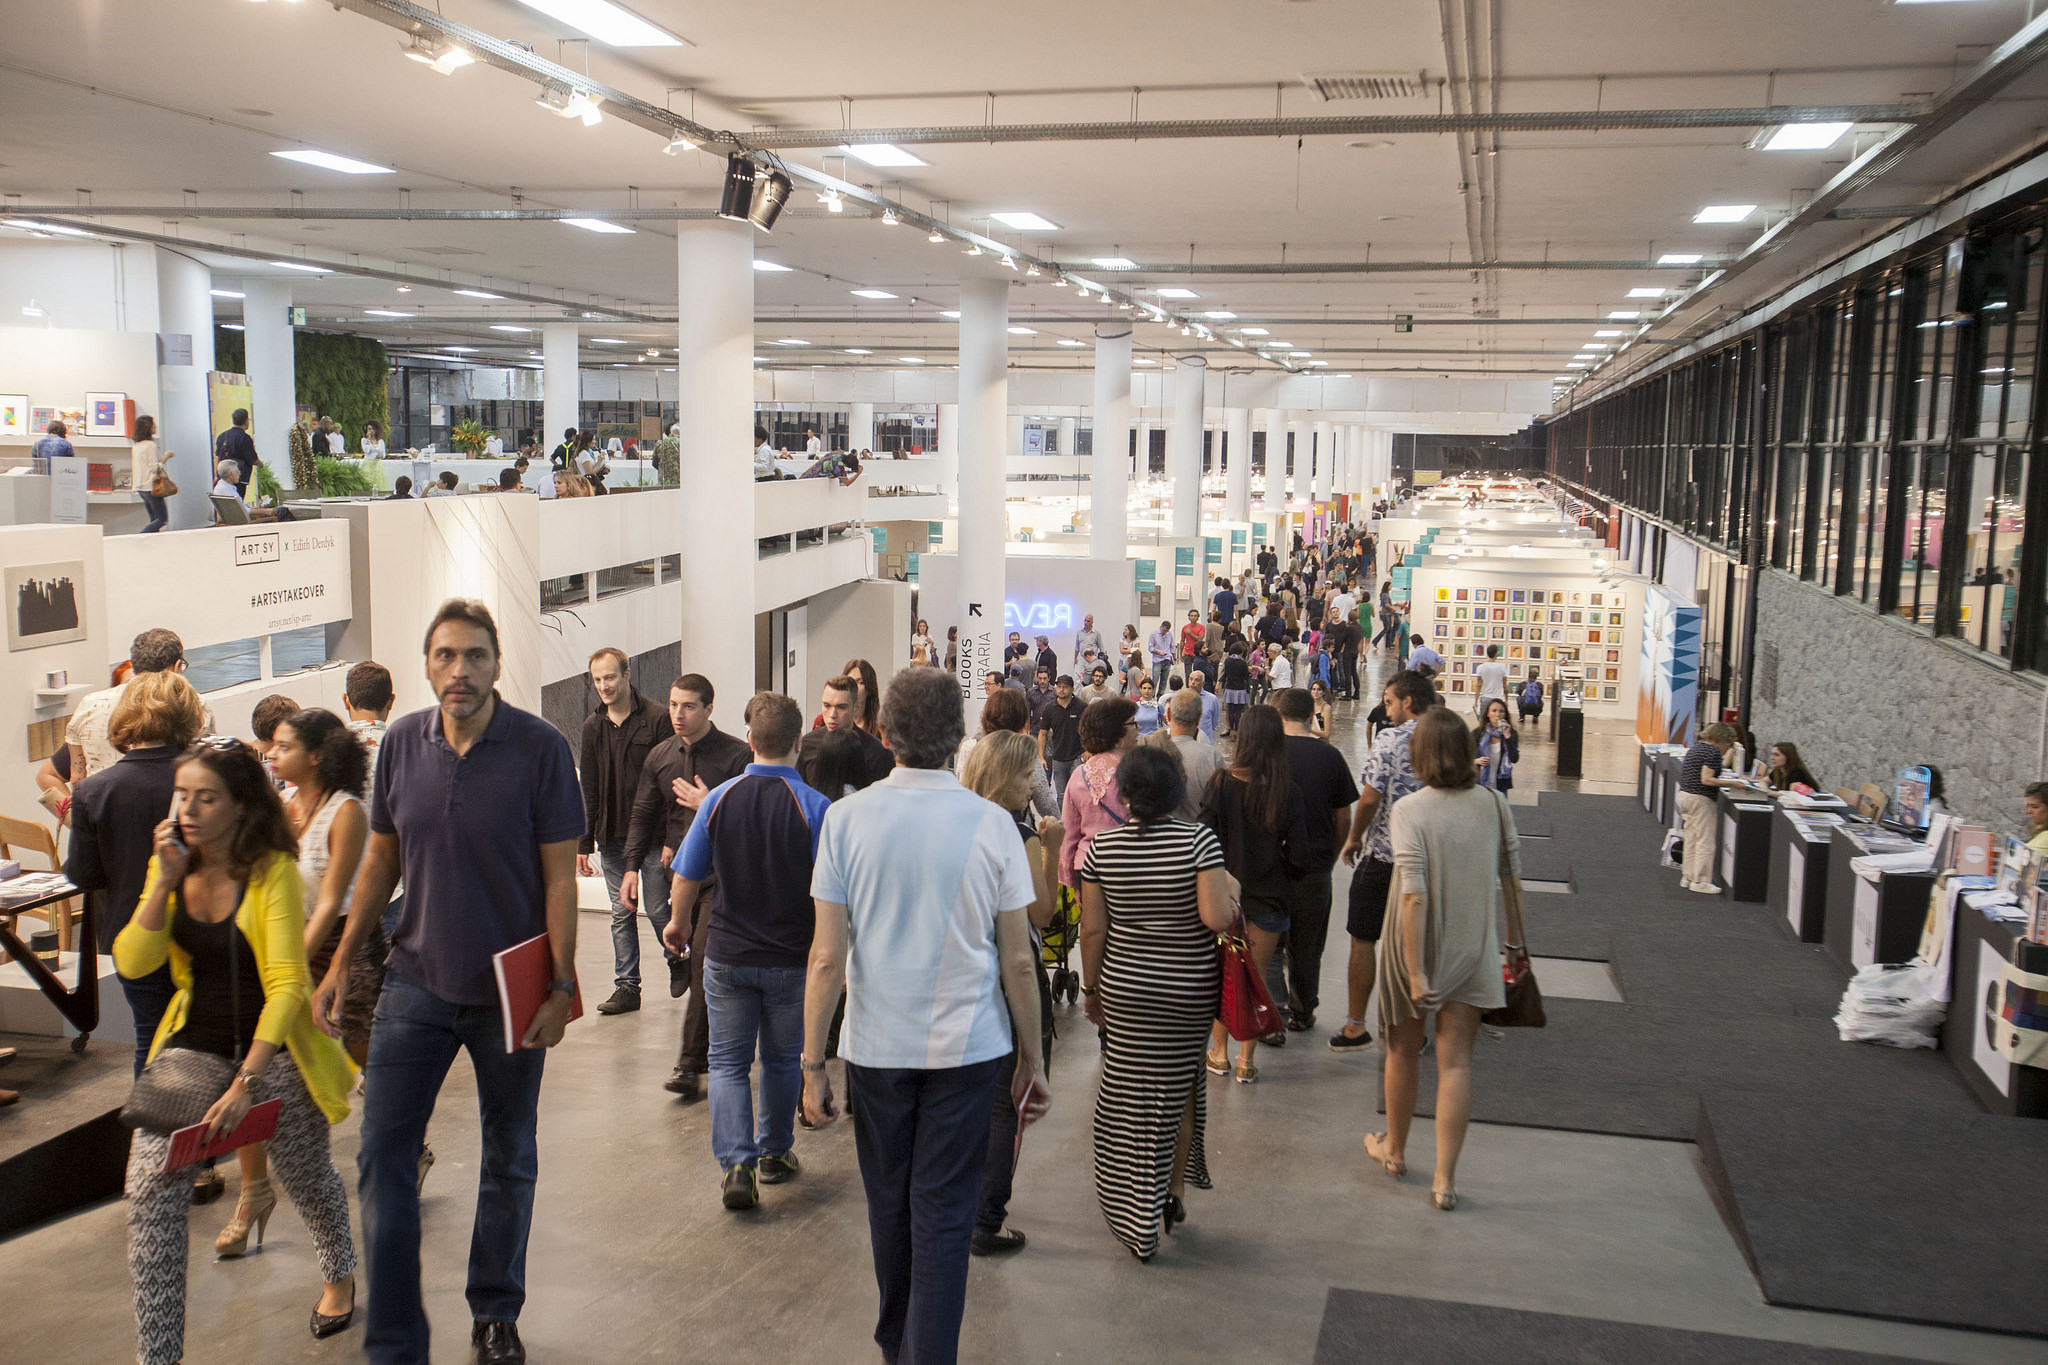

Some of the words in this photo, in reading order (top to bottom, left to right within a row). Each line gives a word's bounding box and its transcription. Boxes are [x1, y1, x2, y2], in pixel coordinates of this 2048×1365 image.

[292, 537, 311, 551] Edith
[251, 584, 325, 608] #ARTSYTAKEOVER
[961, 638, 972, 699] BLOOKS
